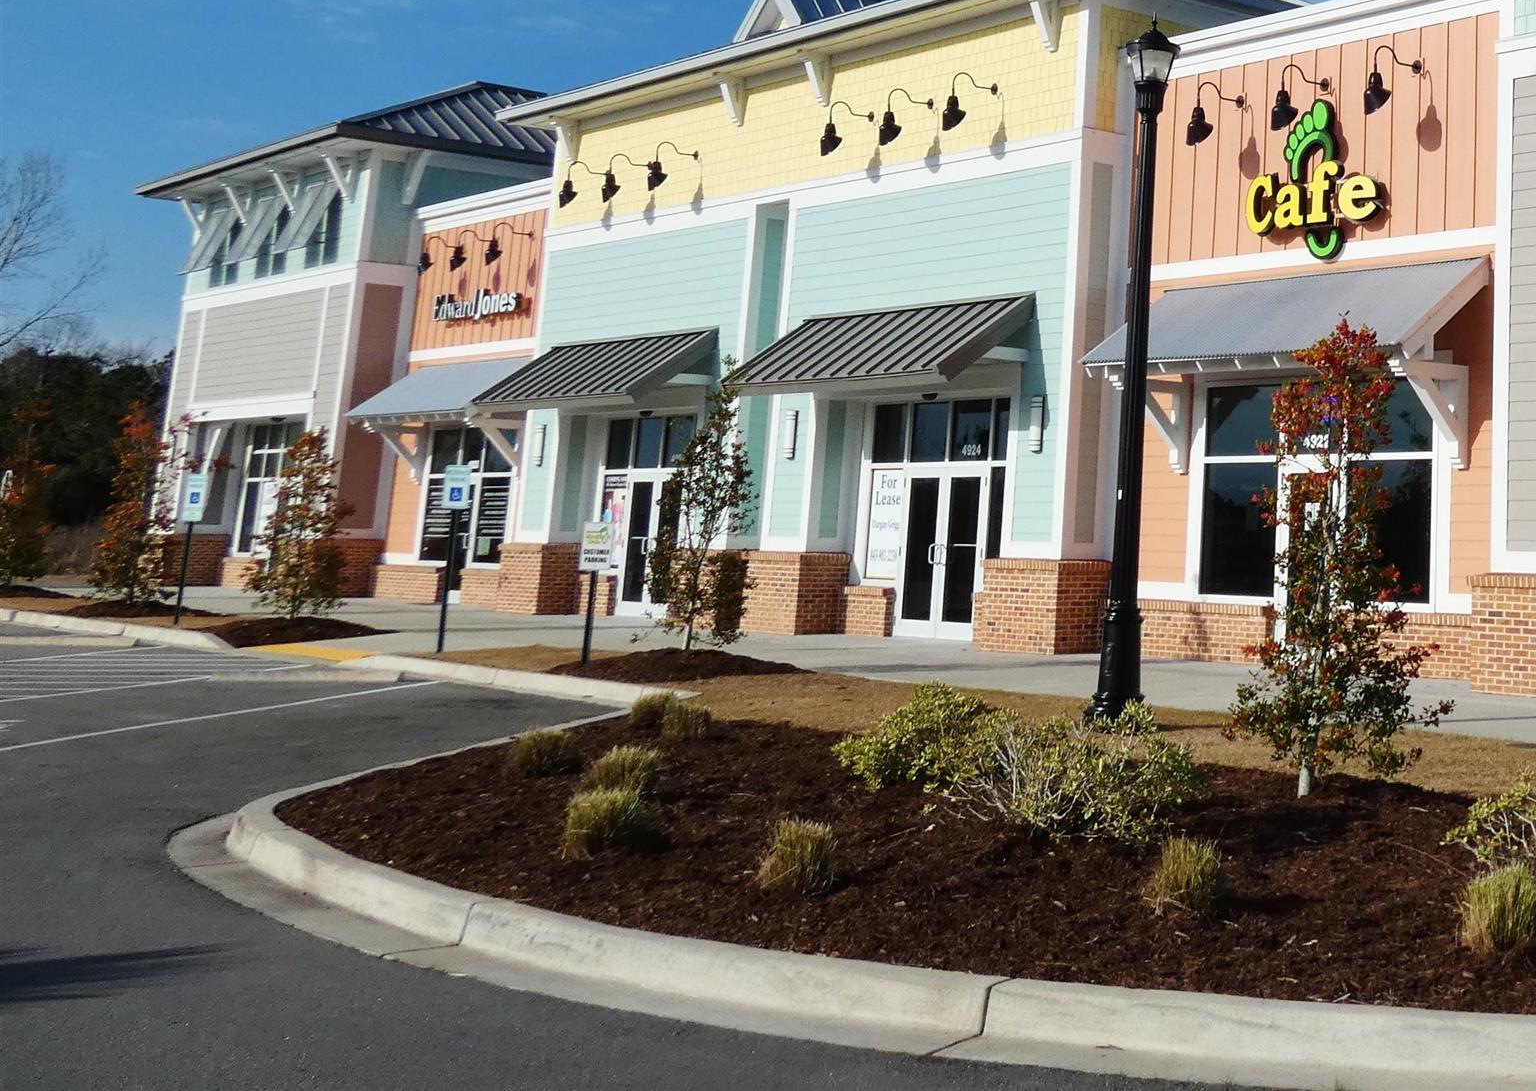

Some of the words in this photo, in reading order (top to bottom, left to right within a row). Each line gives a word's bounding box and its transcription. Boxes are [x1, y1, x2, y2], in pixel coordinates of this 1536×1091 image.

[1245, 161, 1376, 234] Cafe
[961, 444, 981, 455] 4924
[881, 475, 898, 489] For
[875, 491, 901, 505] Lease
